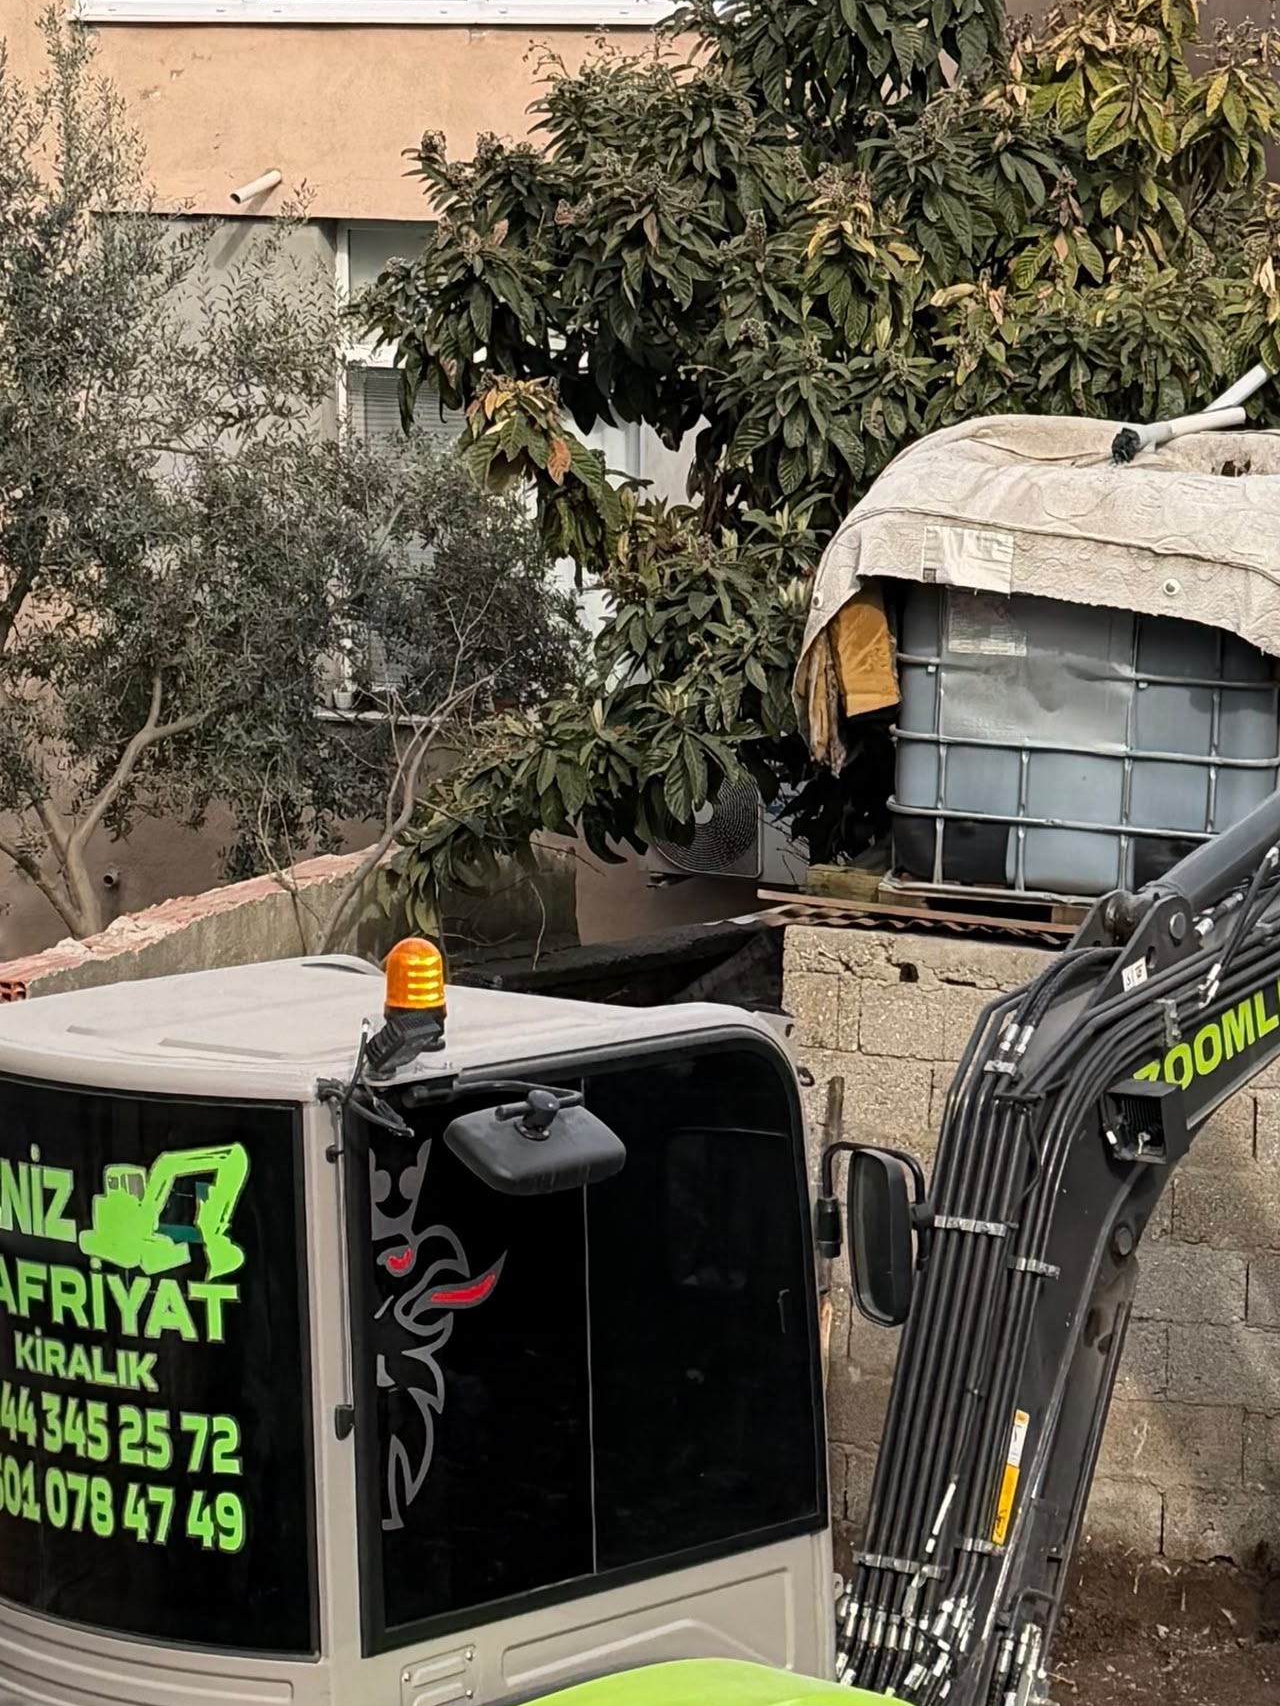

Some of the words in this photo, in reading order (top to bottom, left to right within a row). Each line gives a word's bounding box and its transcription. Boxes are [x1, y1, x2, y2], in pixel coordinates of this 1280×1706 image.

[14, 1327, 159, 1392] KİRALIK
[41, 1391, 110, 1462] 345
[118, 1405, 173, 1471] 25
[180, 1411, 243, 1476] 72
[45, 1467, 115, 1538] 078
[123, 1482, 176, 1546] 47
[186, 1490, 246, 1554] 49
